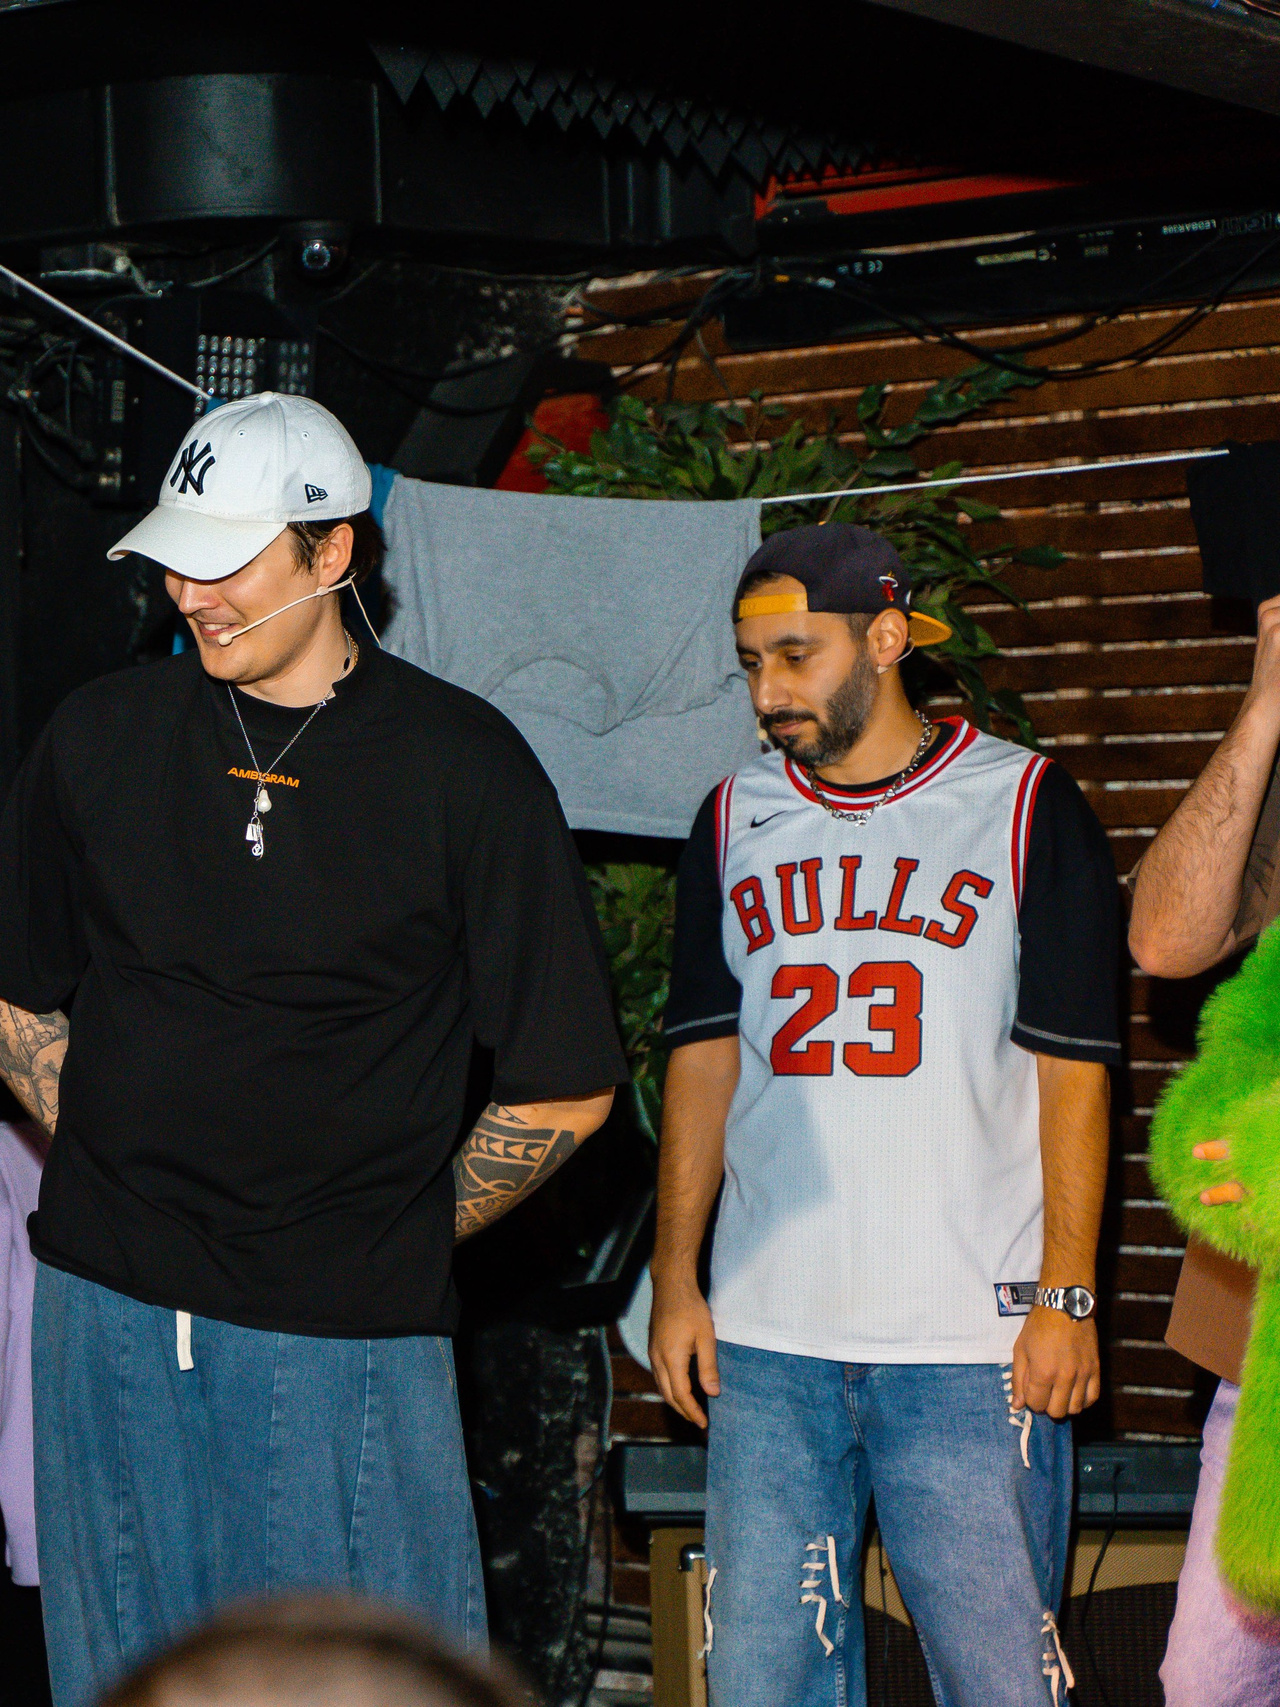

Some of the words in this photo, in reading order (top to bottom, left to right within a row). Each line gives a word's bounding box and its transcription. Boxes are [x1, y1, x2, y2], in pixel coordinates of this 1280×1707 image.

[170, 439, 216, 496] NY
[227, 767, 300, 788] AMBIGRAM
[730, 855, 995, 956] BULLS
[770, 960, 924, 1077] 23
